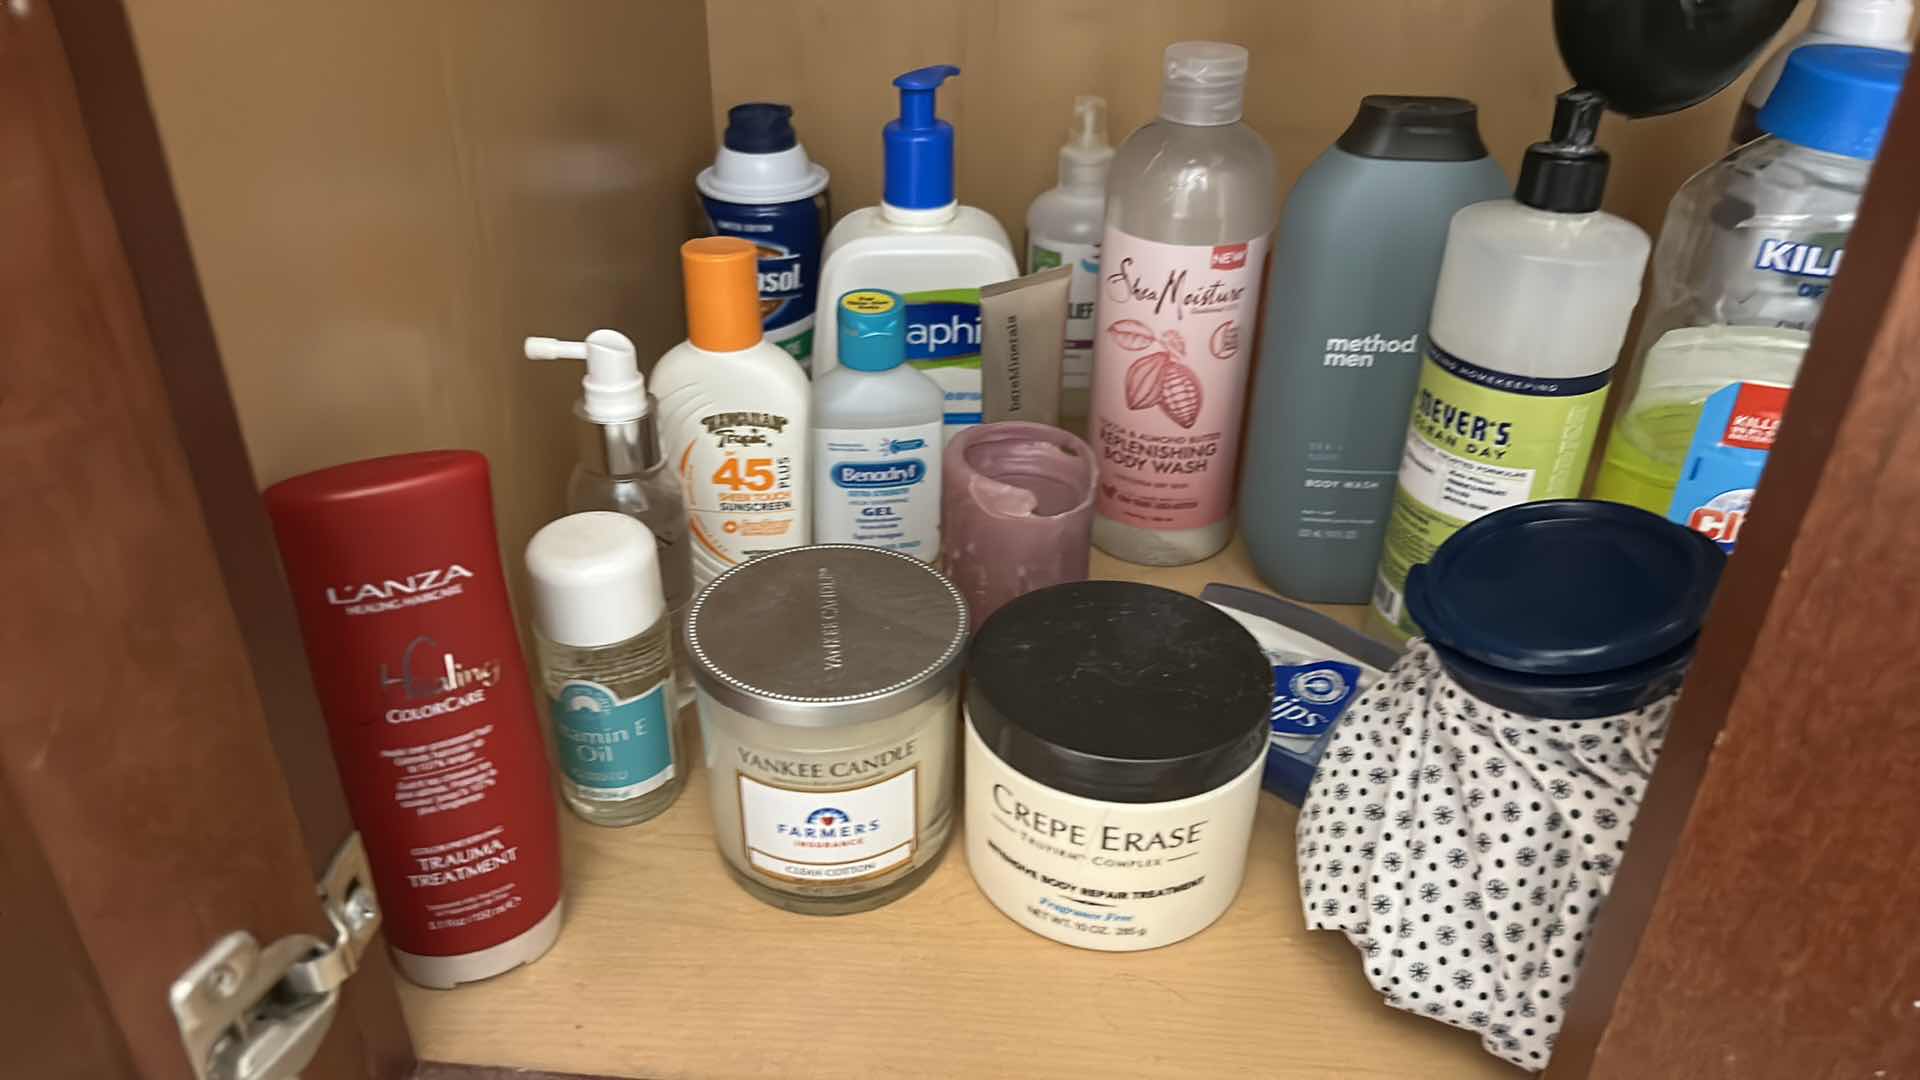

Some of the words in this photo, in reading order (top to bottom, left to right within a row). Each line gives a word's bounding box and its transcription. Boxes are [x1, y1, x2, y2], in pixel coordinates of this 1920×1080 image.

[1326, 333, 1418, 353] method
[1323, 351, 1374, 368] men
[1466, 442, 1508, 460] DAY
[711, 457, 777, 492] 45
[1151, 459, 1209, 475] WASH
[719, 501, 792, 511] SUNSCREEN
[861, 506, 896, 516] GEL
[634, 717, 649, 737] E
[737, 746, 823, 778] YANKEE
[829, 737, 919, 778] CANDLE
[776, 818, 881, 838] FARMERS
[415, 839, 505, 872] TRAUMA
[407, 846, 520, 888] TREATMENT
[1040, 873, 1078, 892] BODY
[1080, 885, 1128, 900] REPAIR
[1132, 874, 1206, 900] TREATMENT
